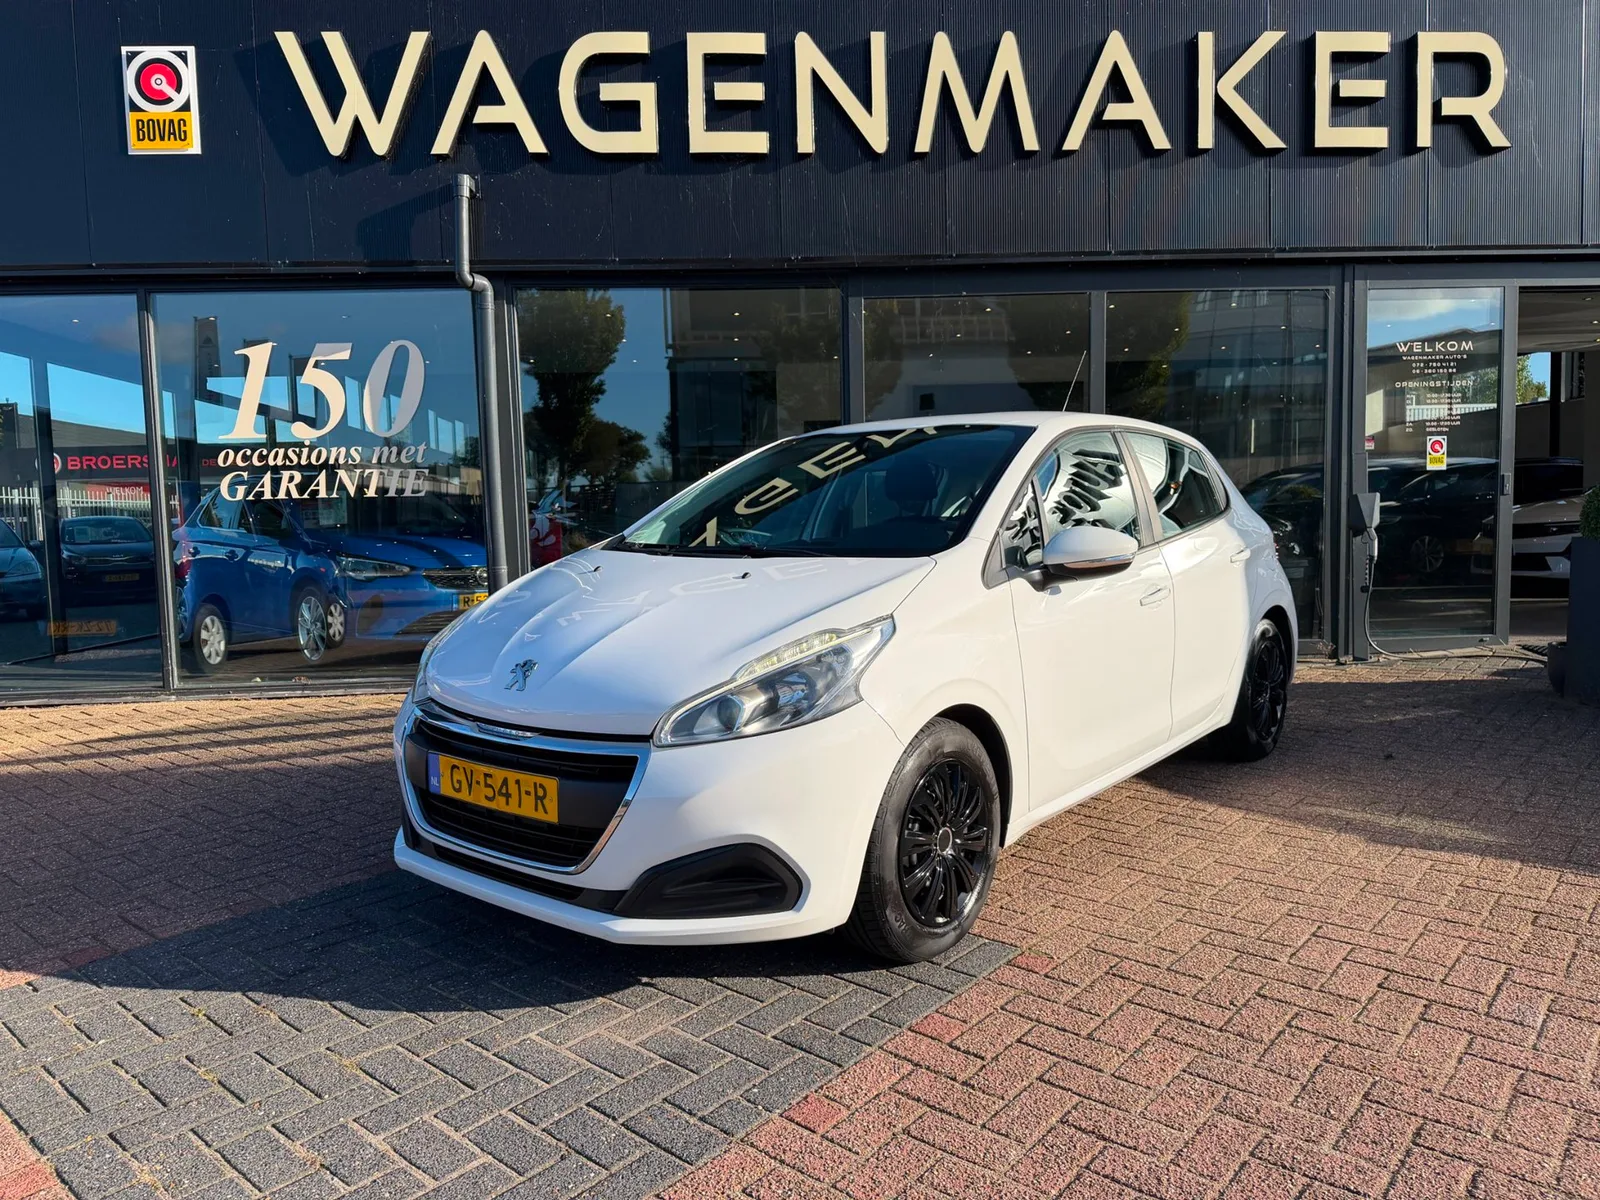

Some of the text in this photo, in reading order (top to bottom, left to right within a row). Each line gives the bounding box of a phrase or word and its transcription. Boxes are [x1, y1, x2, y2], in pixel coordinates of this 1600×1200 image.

[274, 30, 1512, 156] WAGENMAKER
[136, 118, 188, 142] BOVAG
[1396, 341, 1473, 353] WELKOM
[218, 339, 426, 440] 150
[1395, 380, 1473, 388] OPENINGSTIJDEN
[67, 455, 178, 470] BROERS
[217, 440, 427, 468] occasions met
[220, 468, 430, 501] GARANTIE
[430, 763, 549, 815] NL GV-541-R
